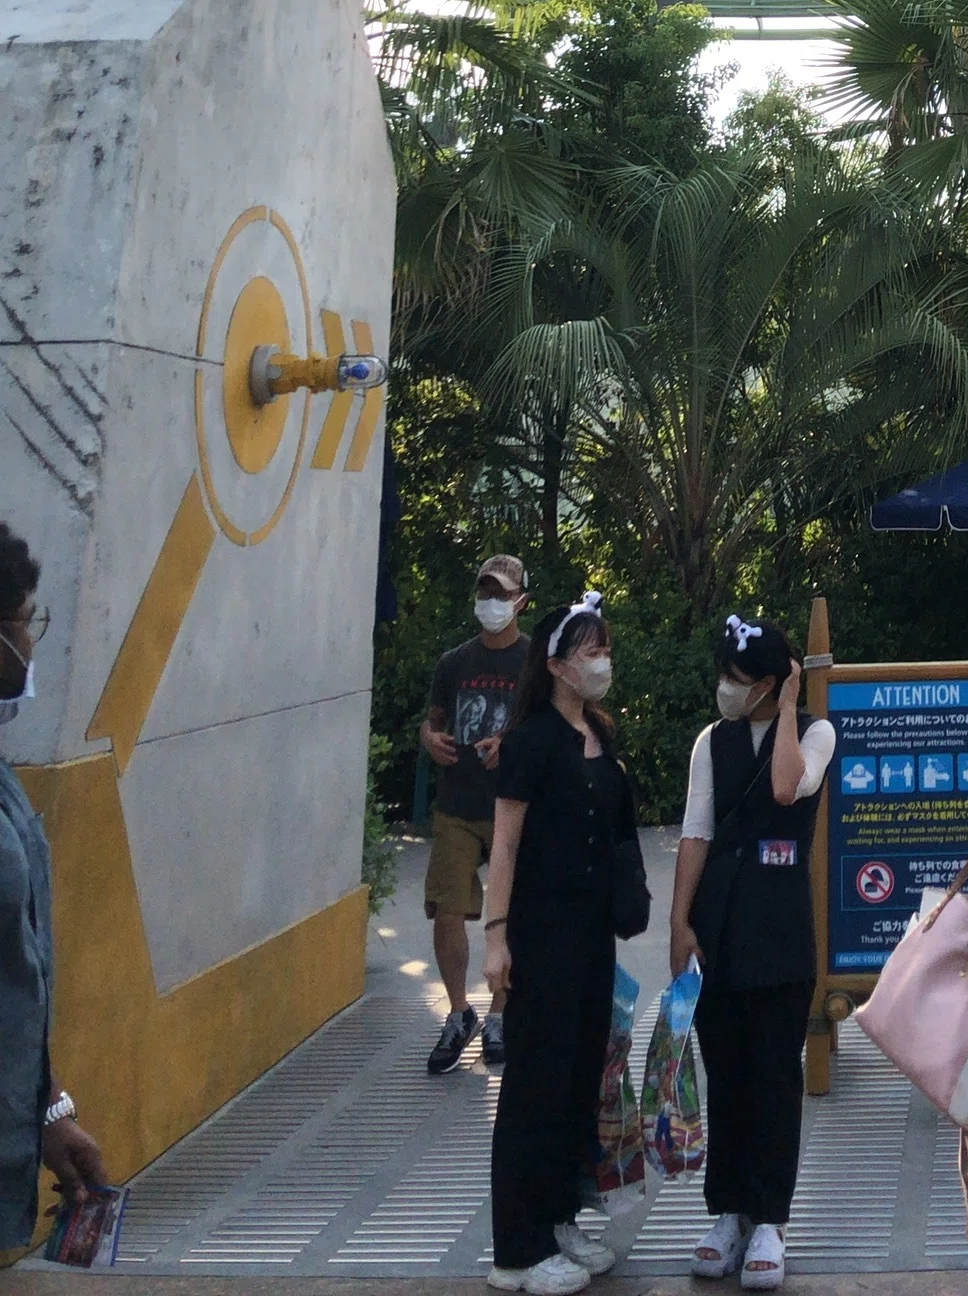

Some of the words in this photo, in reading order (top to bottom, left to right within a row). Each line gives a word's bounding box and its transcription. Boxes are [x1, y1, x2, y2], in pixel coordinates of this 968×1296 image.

[871, 684, 960, 707] ATTENTION
[843, 731, 865, 740] Please
[867, 730, 889, 739] follow
[891, 730, 903, 738] the
[904, 729, 945, 740] precautions
[946, 728, 968, 737] below
[867, 740, 912, 750] experiencing
[861, 934, 883, 944] Thank
[885, 936, 900, 945] you
